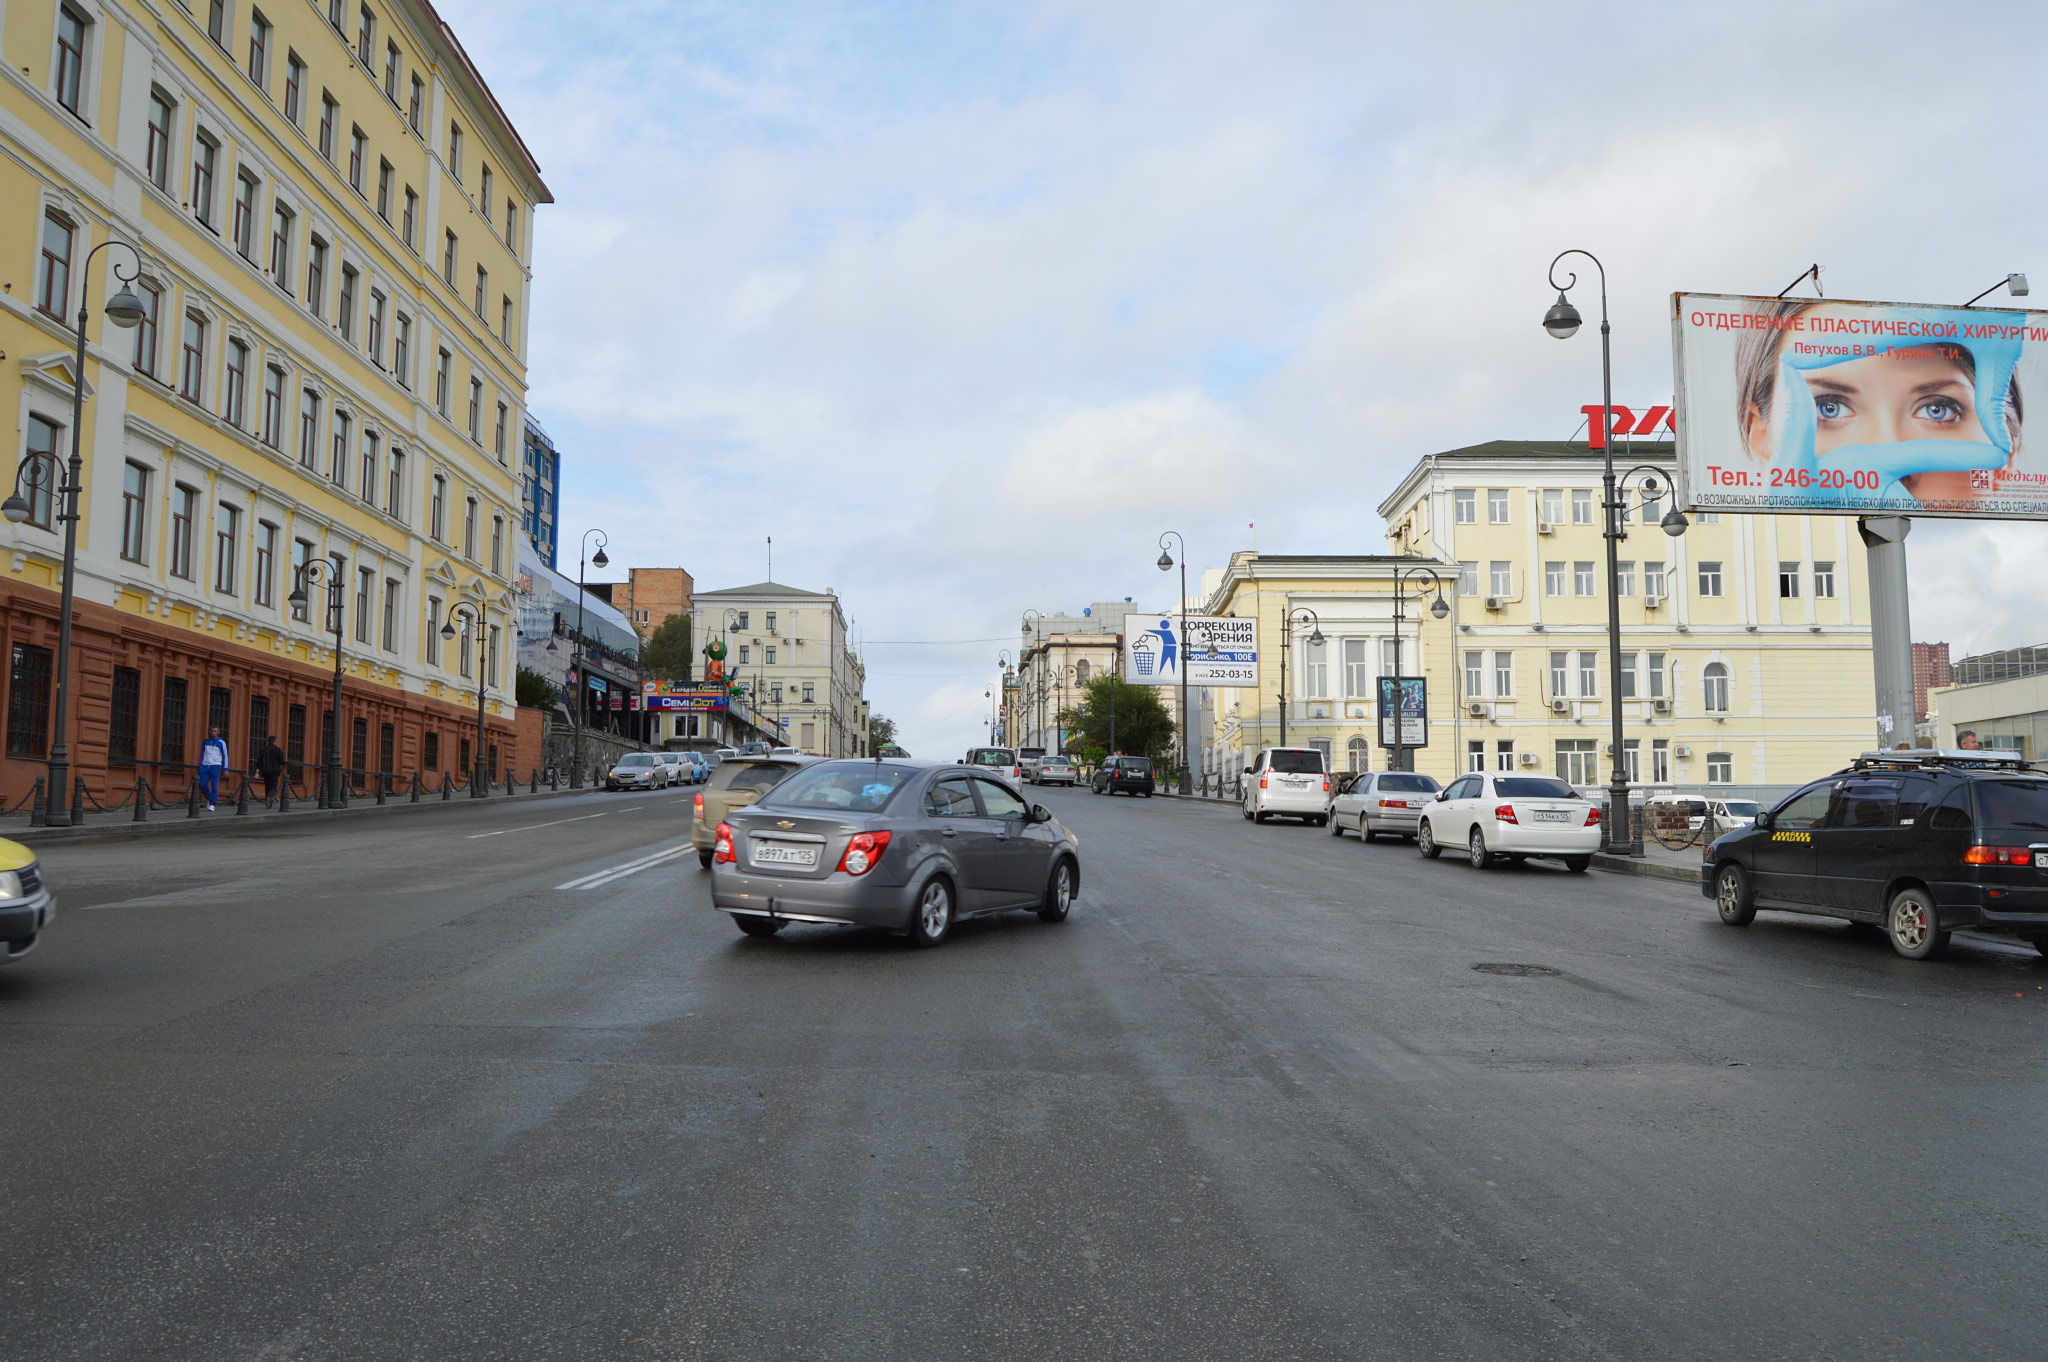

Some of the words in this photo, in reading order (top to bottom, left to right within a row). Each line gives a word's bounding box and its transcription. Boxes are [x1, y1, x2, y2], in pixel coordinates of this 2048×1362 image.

[1691, 311, 1805, 331] ОТДЕЛЕНИЕ
[1810, 317, 1958, 338] ПЛАСТИЧЕСКОЙ
[1794, 342, 1849, 358] Петухов
[1887, 346, 1935, 361] Гурина
[1938, 347, 1963, 360] Т.И.
[1707, 466, 1762, 487] Тел.:
[1770, 468, 1879, 490] 246-20-00
[1993, 469, 2048, 485] Медклу
[1697, 494, 1702, 504] О
[1704, 494, 1757, 506] ВОЗМОЖНЫХ
[1758, 495, 1846, 508] ПРОТИВОПОКАЗАНИЯХ
[1848, 497, 1901, 509] НЕОБХОДИМО
[1902, 499, 2000, 512] ПРОКОНСУЛЬТИРОВАТЬСЯ
[2001, 502, 2012, 512] СО
[1206, 632, 1253, 643] ЗРЕНИЯ
[1209, 669, 1253, 679] 252-03-15
